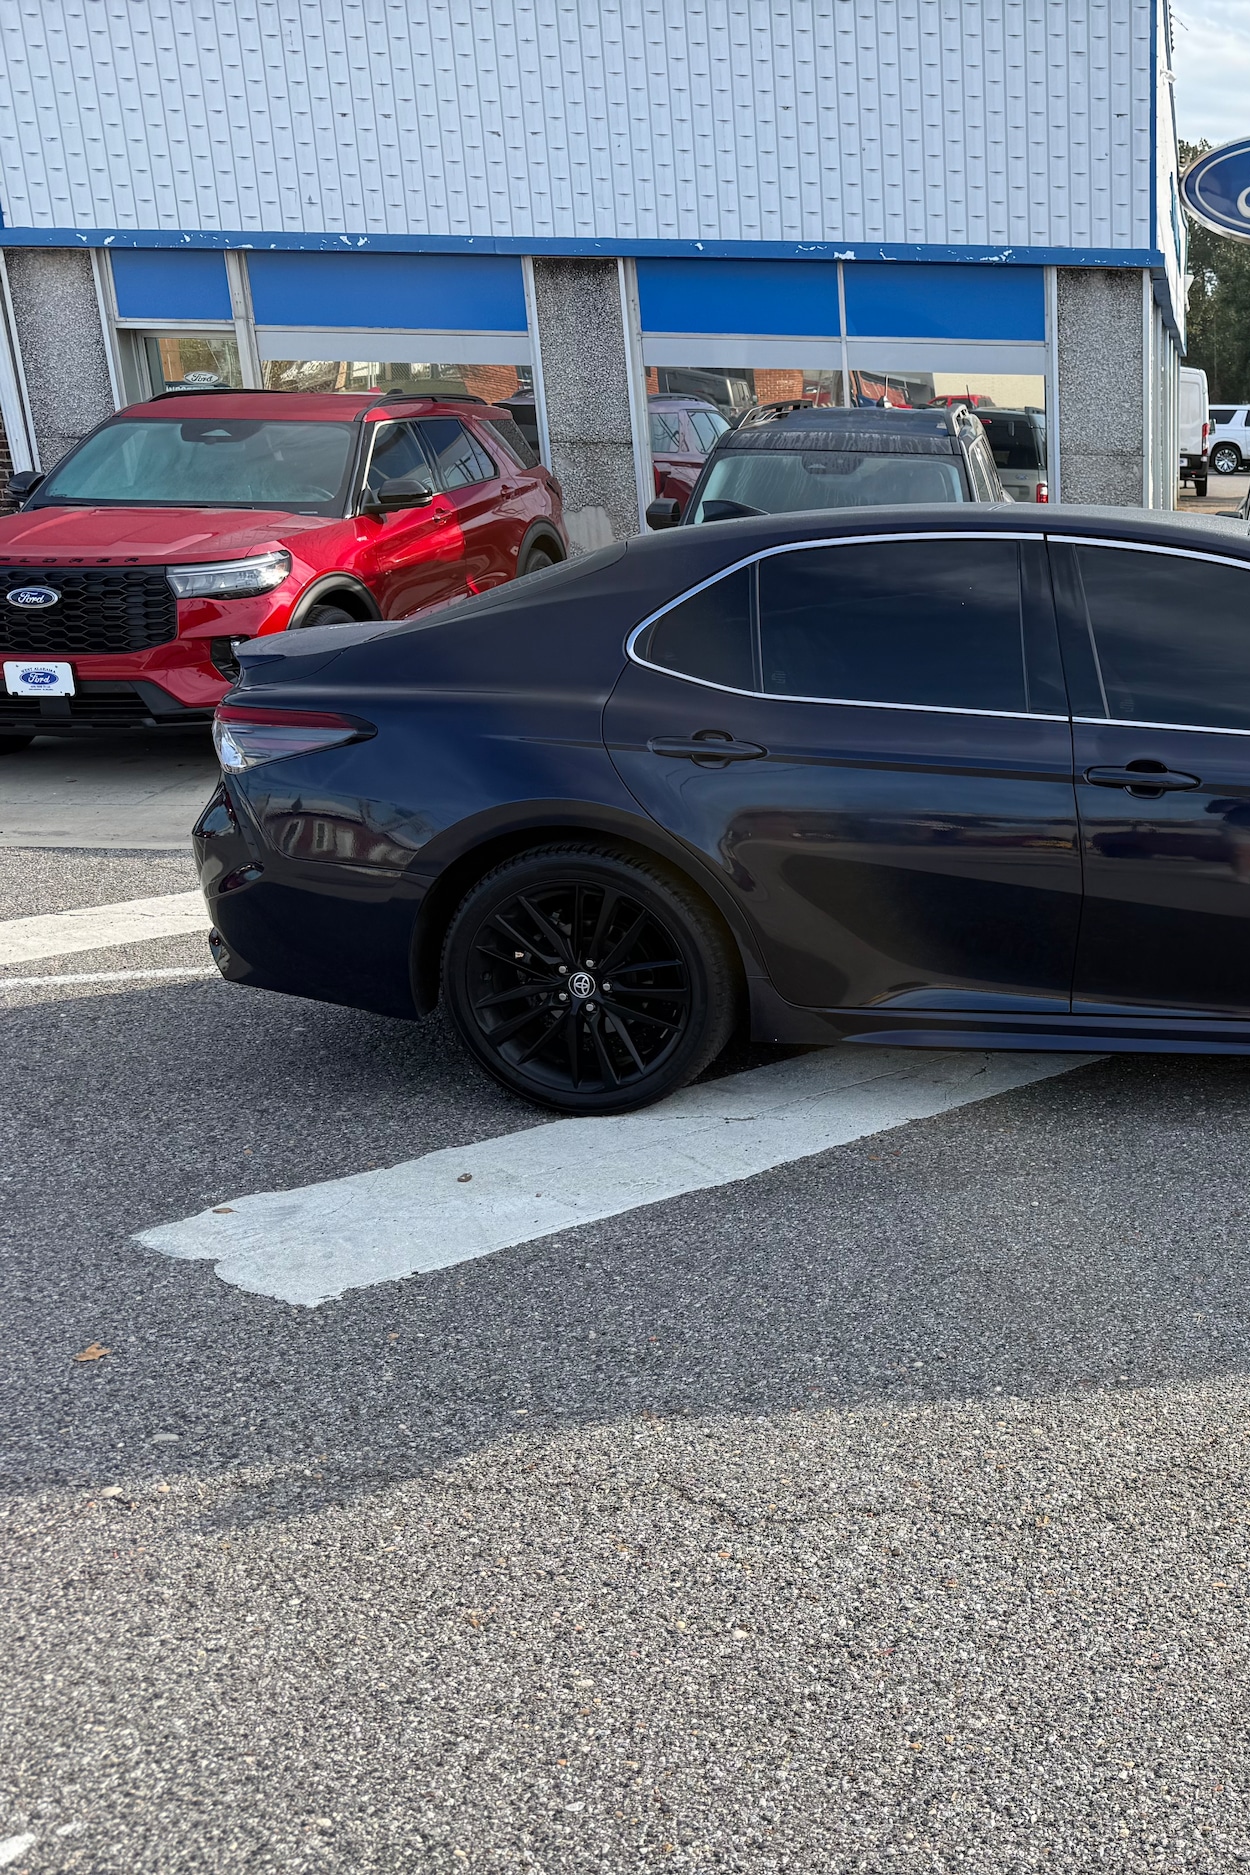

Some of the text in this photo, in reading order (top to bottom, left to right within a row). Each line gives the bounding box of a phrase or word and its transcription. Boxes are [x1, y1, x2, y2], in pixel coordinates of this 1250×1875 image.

[191, 373, 213, 382] Ford
[17, 591, 45, 604] Ford
[27, 672, 51, 684] Ford
